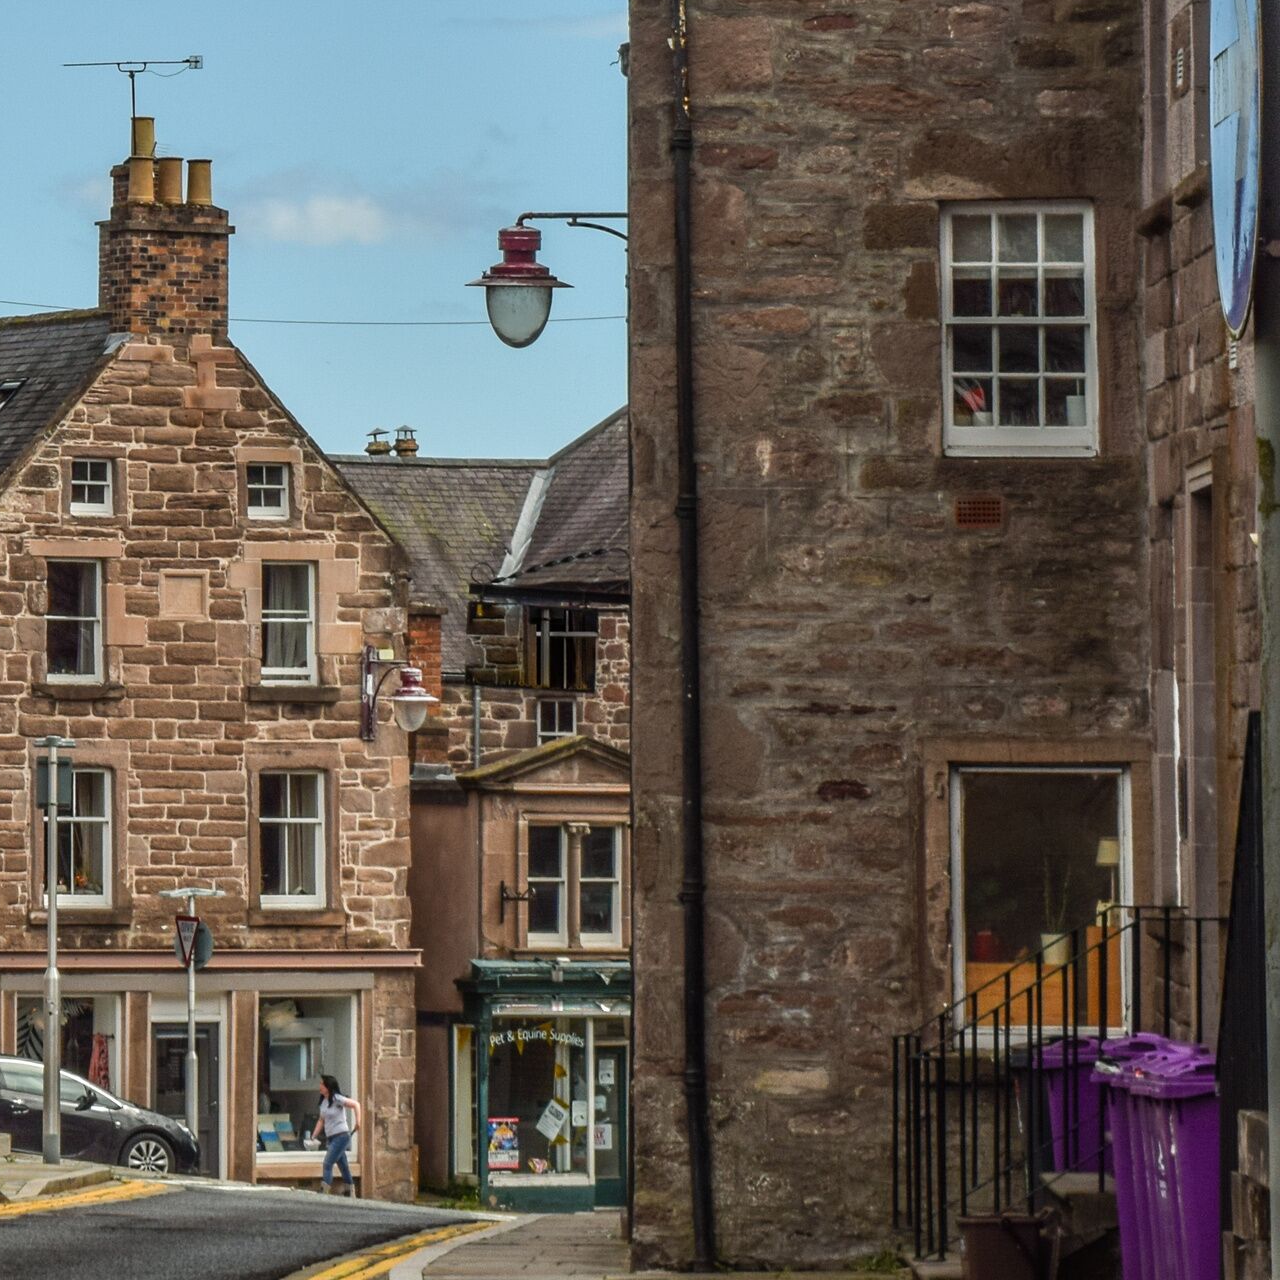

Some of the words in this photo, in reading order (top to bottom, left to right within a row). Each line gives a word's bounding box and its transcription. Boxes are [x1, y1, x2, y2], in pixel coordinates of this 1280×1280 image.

[489, 1032, 504, 1047] Pet
[507, 1029, 515, 1042] &
[517, 1028, 547, 1042] Equine
[550, 1028, 584, 1048] Supplies
